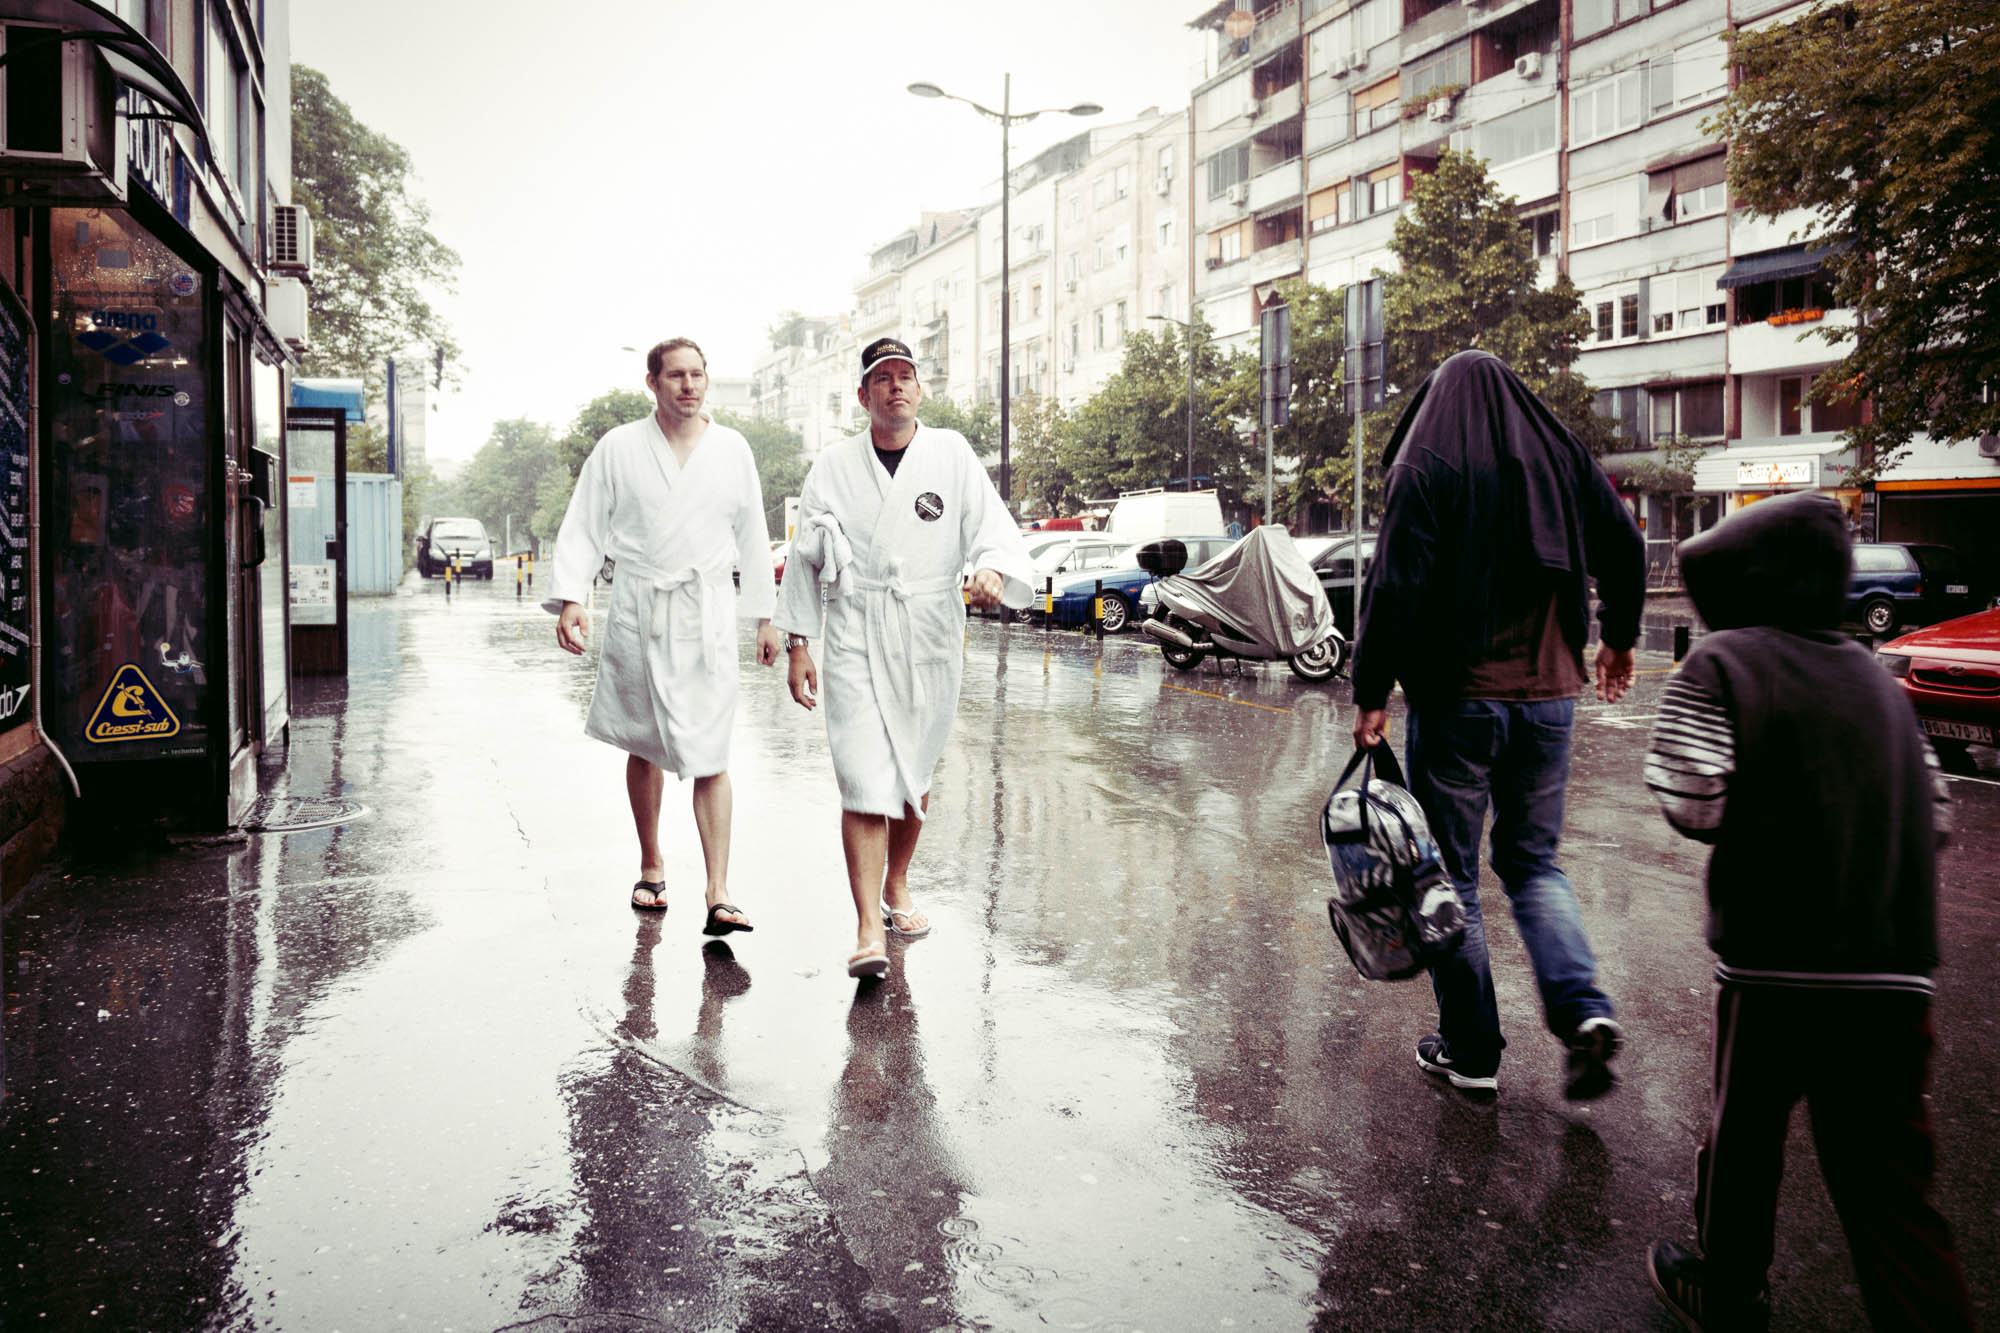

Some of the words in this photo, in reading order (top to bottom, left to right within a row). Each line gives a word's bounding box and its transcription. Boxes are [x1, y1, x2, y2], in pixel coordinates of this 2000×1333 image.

[92, 311, 157, 331] arena
[96, 383, 175, 397] FINIS
[96, 718, 170, 736] Cressi-sub
